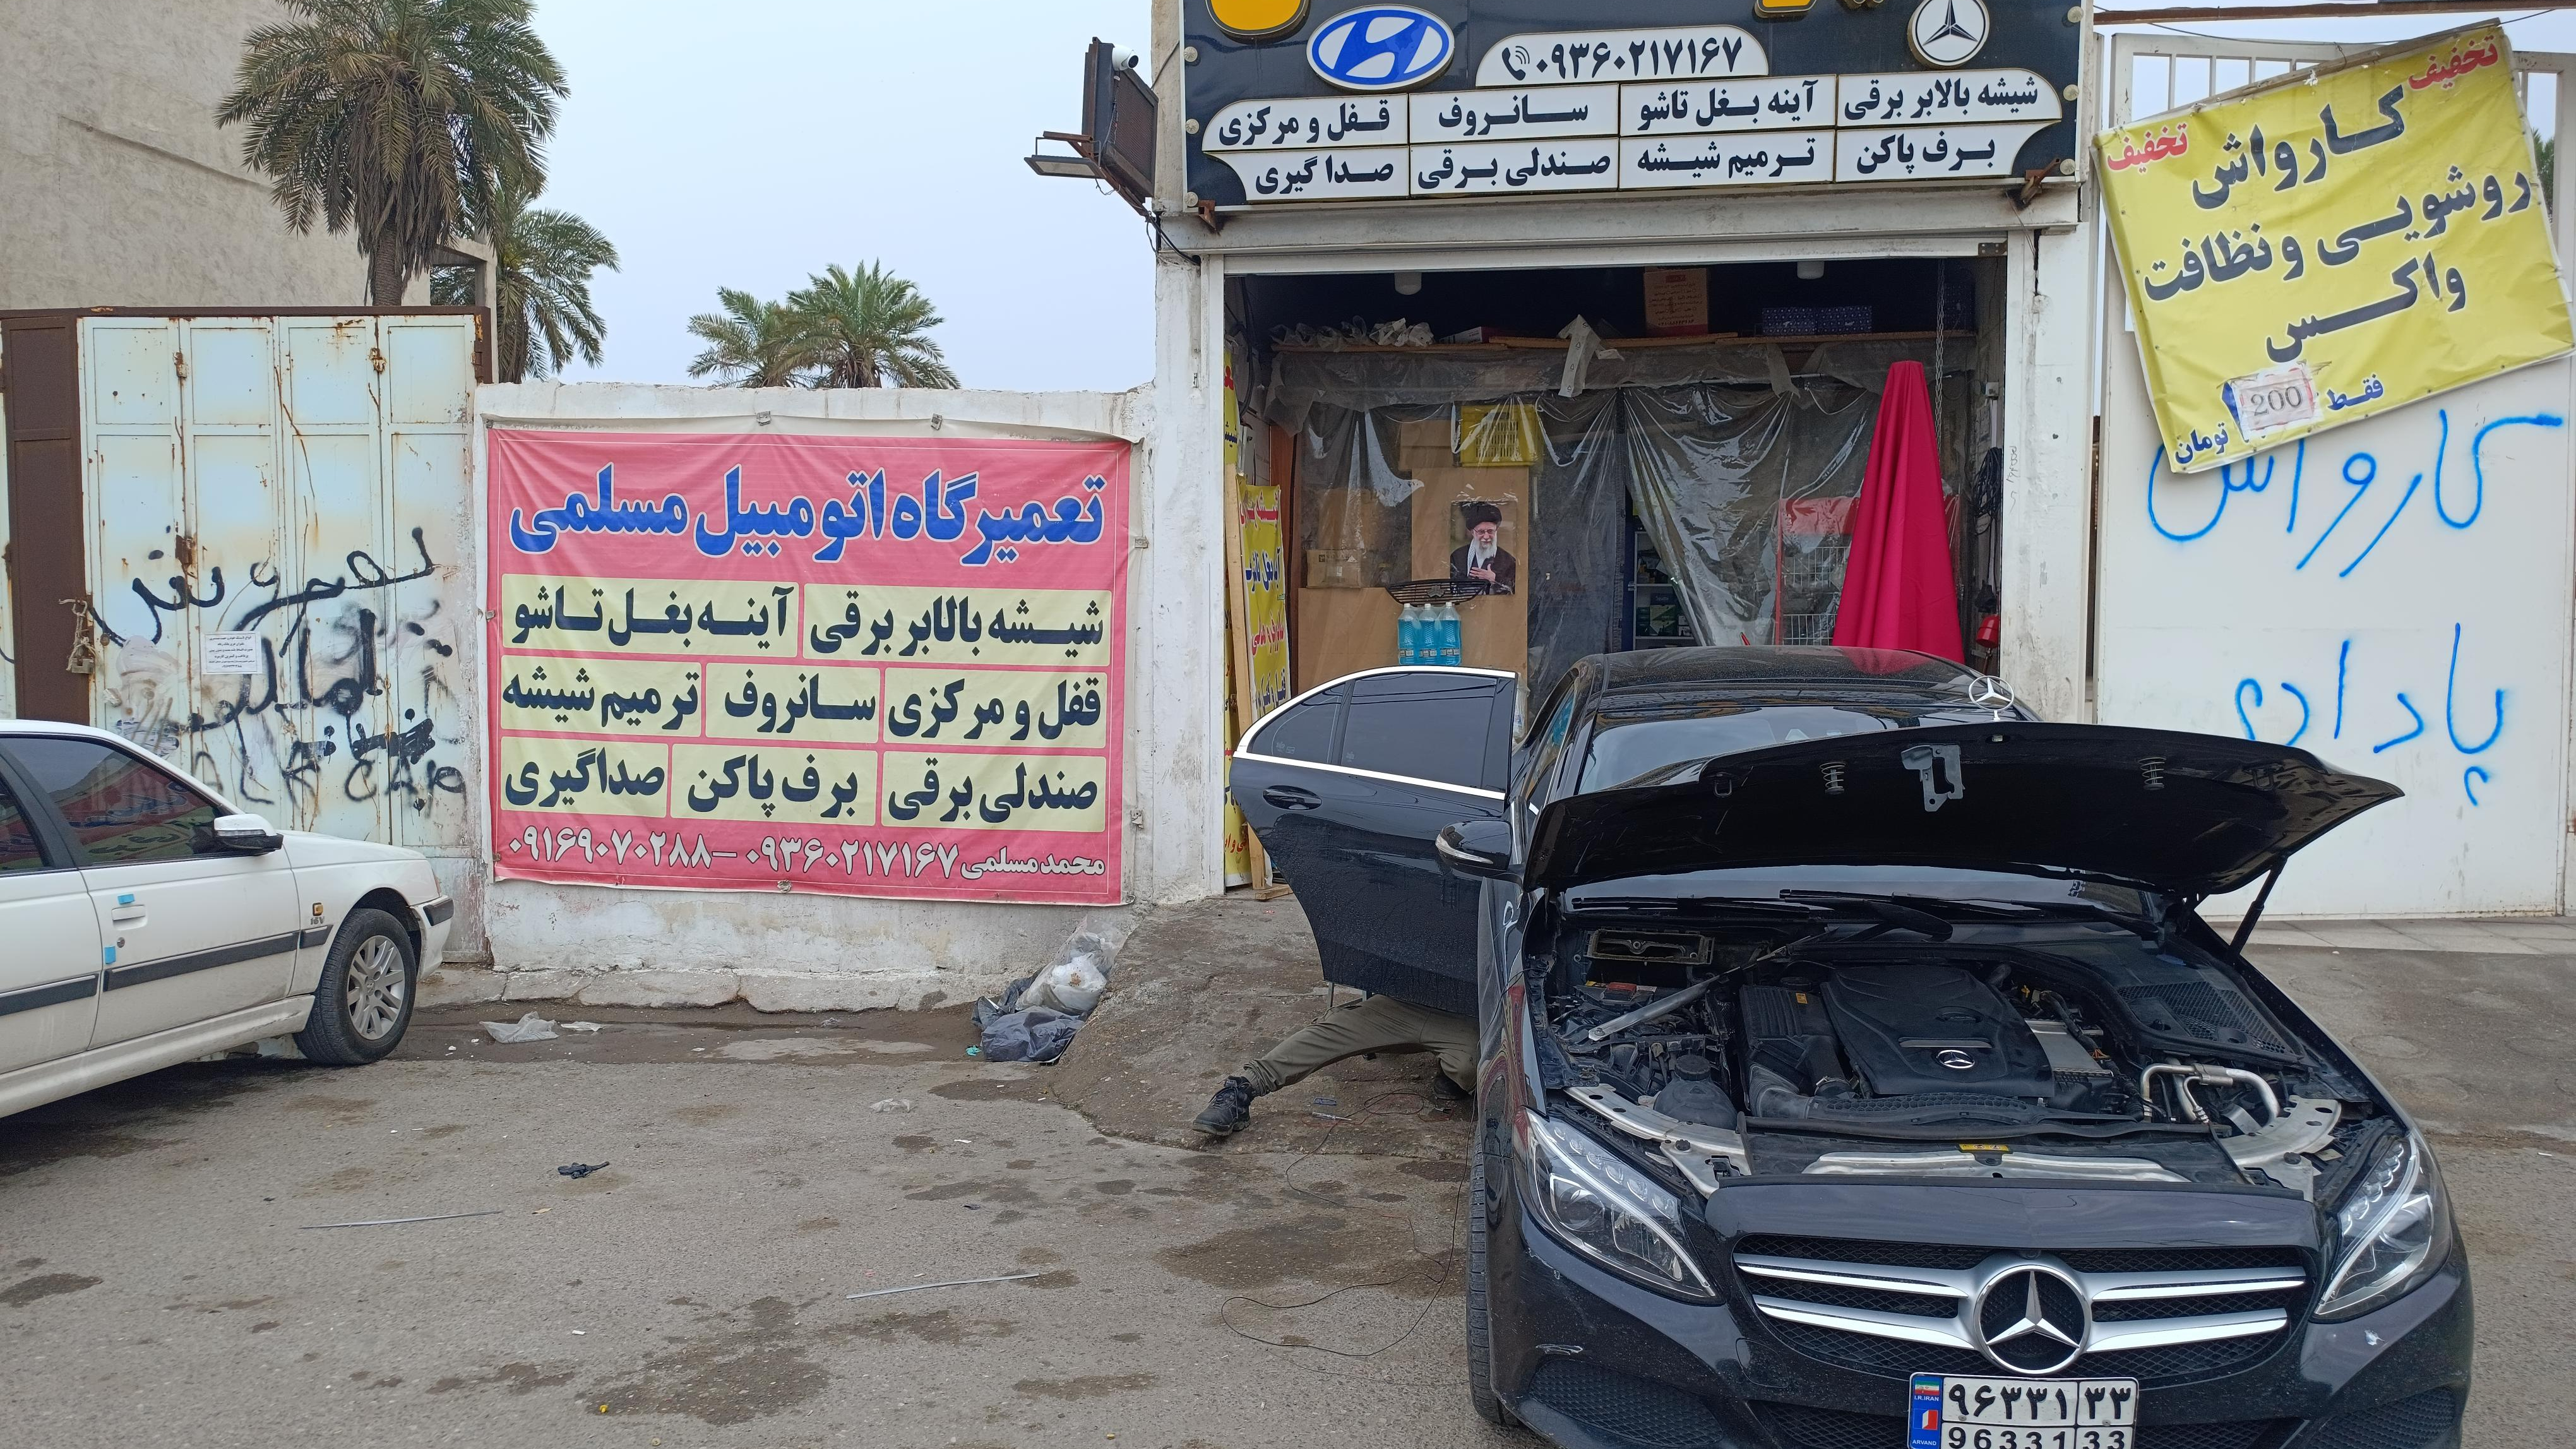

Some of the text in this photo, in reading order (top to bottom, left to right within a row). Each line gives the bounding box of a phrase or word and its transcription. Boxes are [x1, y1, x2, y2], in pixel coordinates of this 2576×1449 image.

[1535, 35, 1743, 80] ۰۹۳۶۰۲۱۷۱۶۷
[2408, 35, 2499, 91] تخفیف
[1219, 99, 1390, 146] قفل و مرکزی
[1438, 94, 1589, 136] سانروف
[1637, 79, 1819, 131] آینه بغل تاشو
[1844, 76, 2038, 121] شیشه بالابر برقی
[1418, 147, 1611, 189] صندلی برقی
[1637, 136, 1815, 179] ترمیم شیشه
[1856, 130, 1996, 174] برف پاکن
[2106, 123, 2189, 174] تخفیف
[2191, 85, 2406, 210] کارواش
[2144, 165, 2531, 301] روشویی و نظافت
[2267, 252, 2466, 363] واکس
[2250, 386, 2302, 417] 200
[2327, 373, 2384, 411] فقط
[2174, 423, 2229, 465] تومان
[508, 461, 1108, 567] تعمیرگاه اتومبیل مسلمی
[511, 584, 795, 650] آینه بغل تاشو
[809, 590, 1104, 659] شیشه بالابر برقی
[502, 665, 596, 724] شیشه
[600, 671, 701, 731] ترمیم
[724, 668, 877, 734] سانروف
[887, 676, 1102, 741] قفل و مرکزی
[687, 753, 859, 819] برف پاکن
[888, 757, 1099, 824] صندلی برقی
[960, 845, 1039, 881] مسلمی
[1039, 853, 1106, 876] محمد
[1948, 1383, 2132, 1420] ۹۶۳۳۱ ۳۳
[1948, 1426, 2126, 1449] 96331 33
